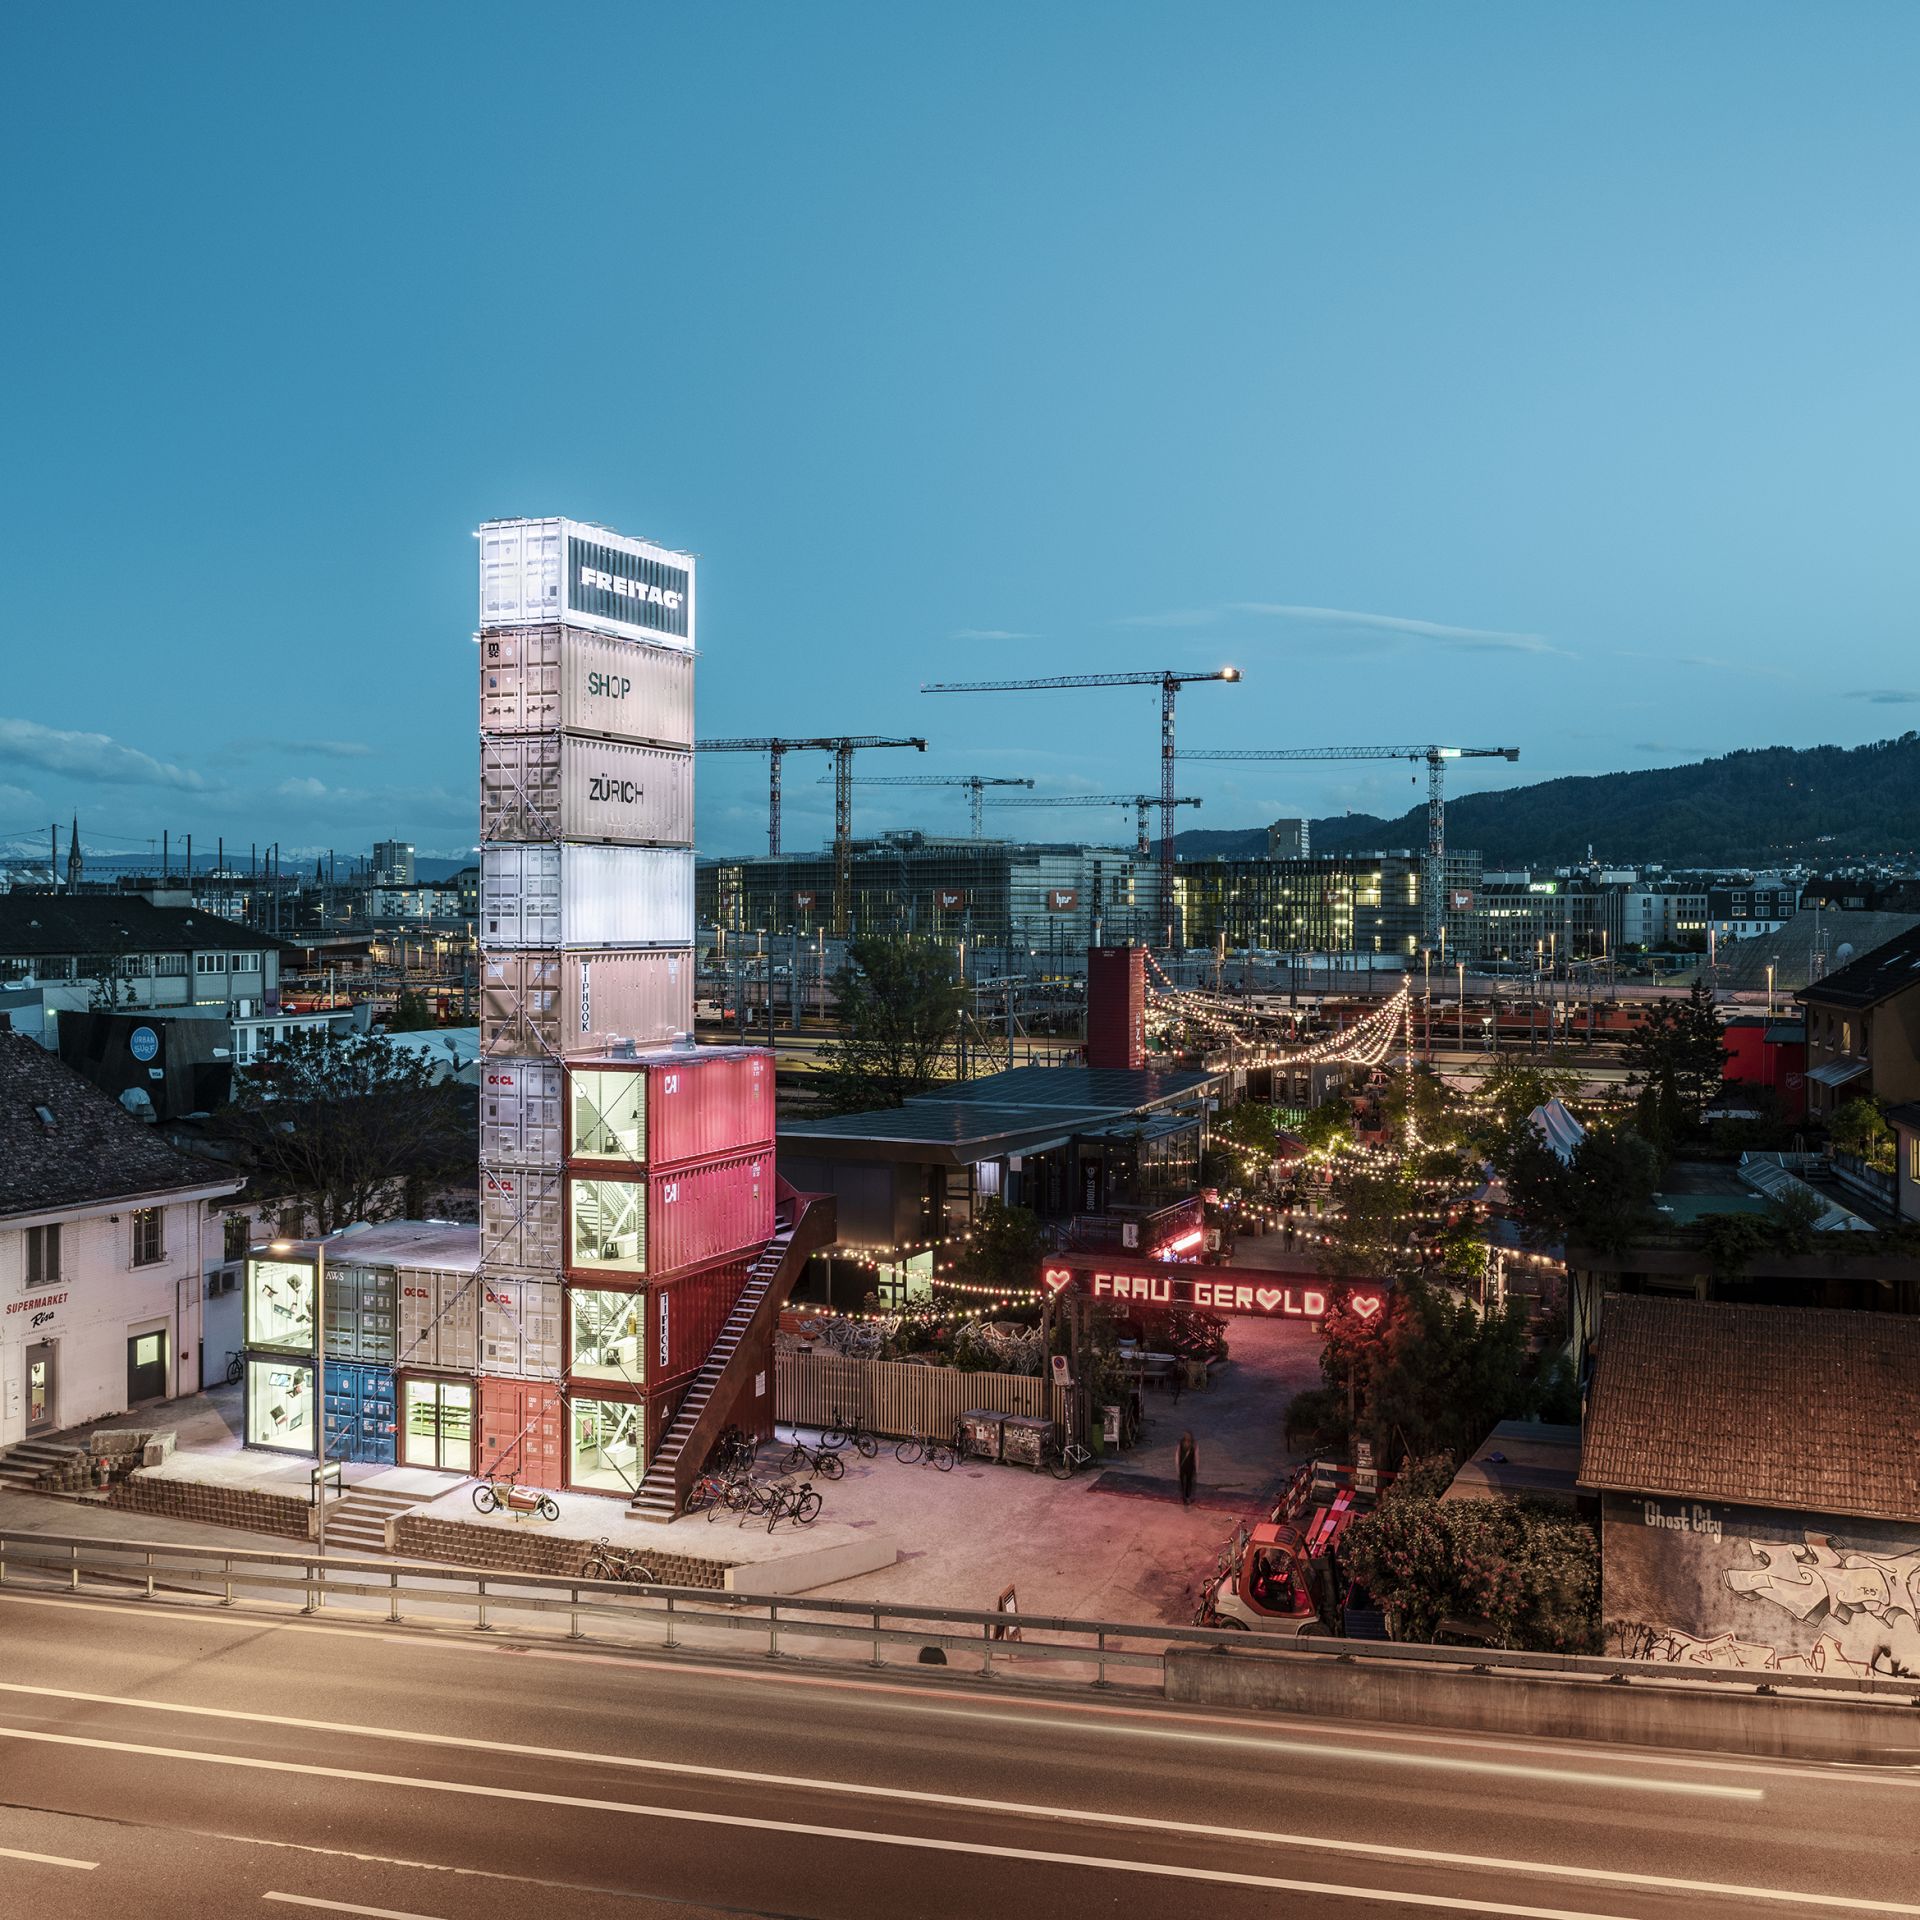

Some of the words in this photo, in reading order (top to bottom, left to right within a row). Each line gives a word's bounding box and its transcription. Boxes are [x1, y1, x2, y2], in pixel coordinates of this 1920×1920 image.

[580, 566, 680, 610] FREITAG
[588, 671, 631, 700] SHOP
[589, 773, 644, 804] ZÜRICH
[581, 963, 590, 1032] TIPHOOK
[134, 1044, 155, 1053] SURF
[1086, 1179, 1096, 1211] STUDIOS
[325, 1271, 345, 1281] AWS
[1093, 1273, 1172, 1304] FRAU
[6, 1292, 69, 1315] SUPERMARKET
[30, 1311, 55, 1329] Risa
